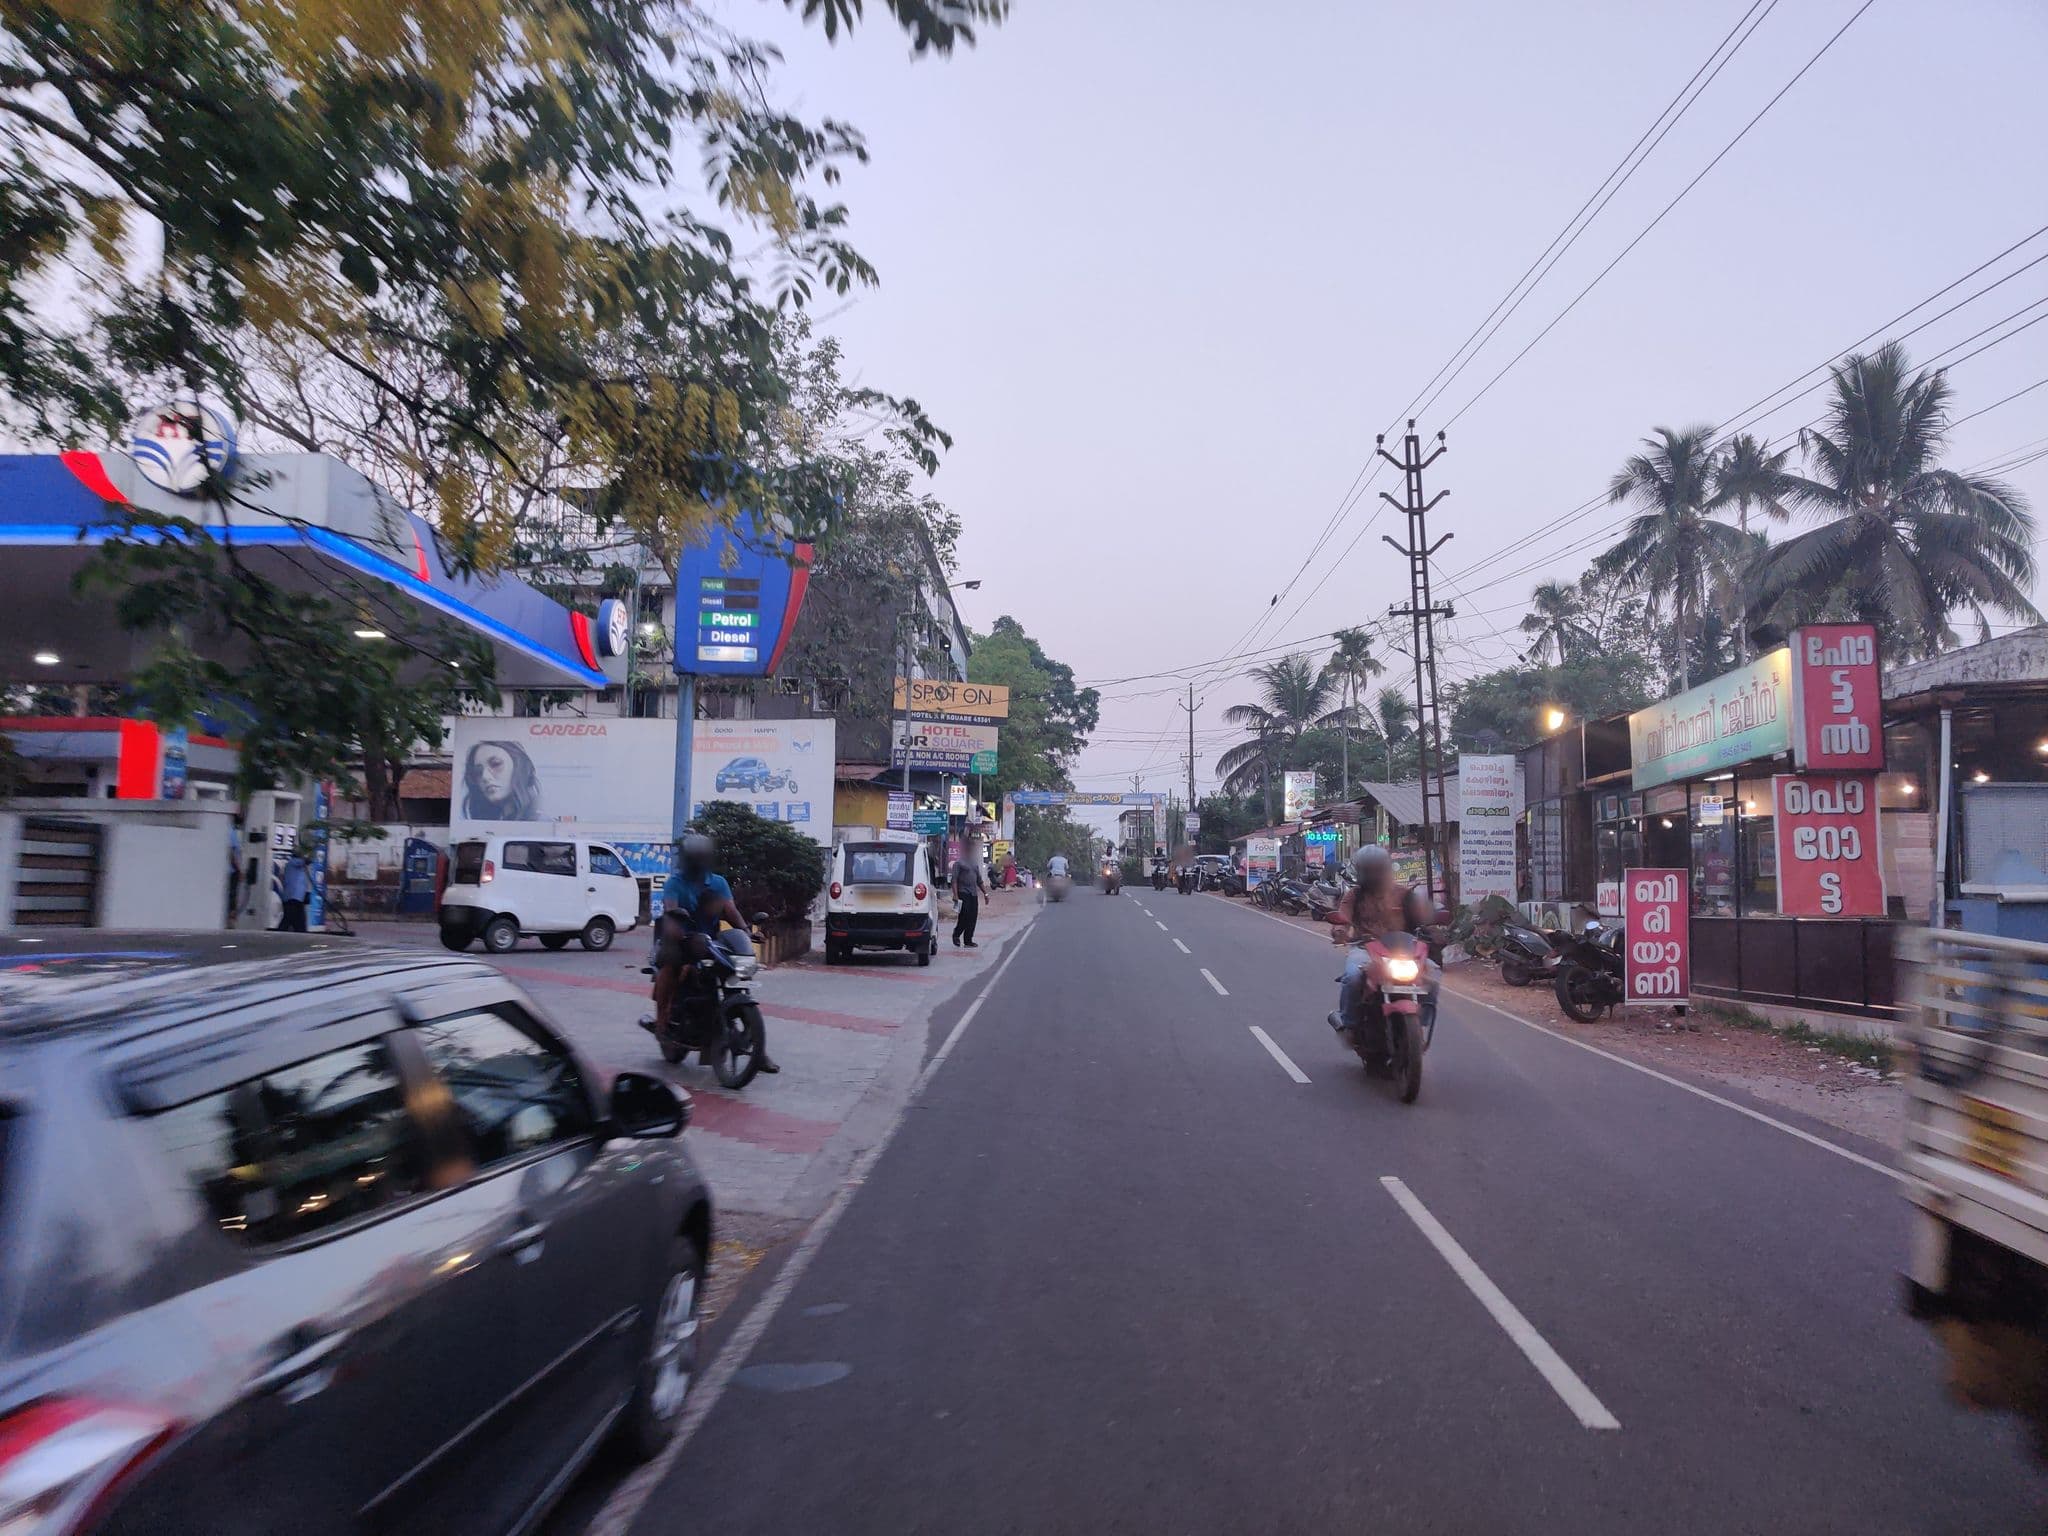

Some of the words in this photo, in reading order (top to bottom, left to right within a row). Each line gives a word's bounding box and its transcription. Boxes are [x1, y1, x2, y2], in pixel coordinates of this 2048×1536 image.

[711, 612, 752, 627] Petrol
[711, 631, 750, 643] Diesel
[912, 684, 958, 703] SPOT
[963, 688, 992, 705] ON
[529, 724, 607, 737] CARRERA
[922, 725, 970, 738] HOTEL
[932, 737, 985, 750] SQUARE
[945, 753, 970, 761] ROOMS
[1632, 874, 1681, 995] ബിരിയാണി
